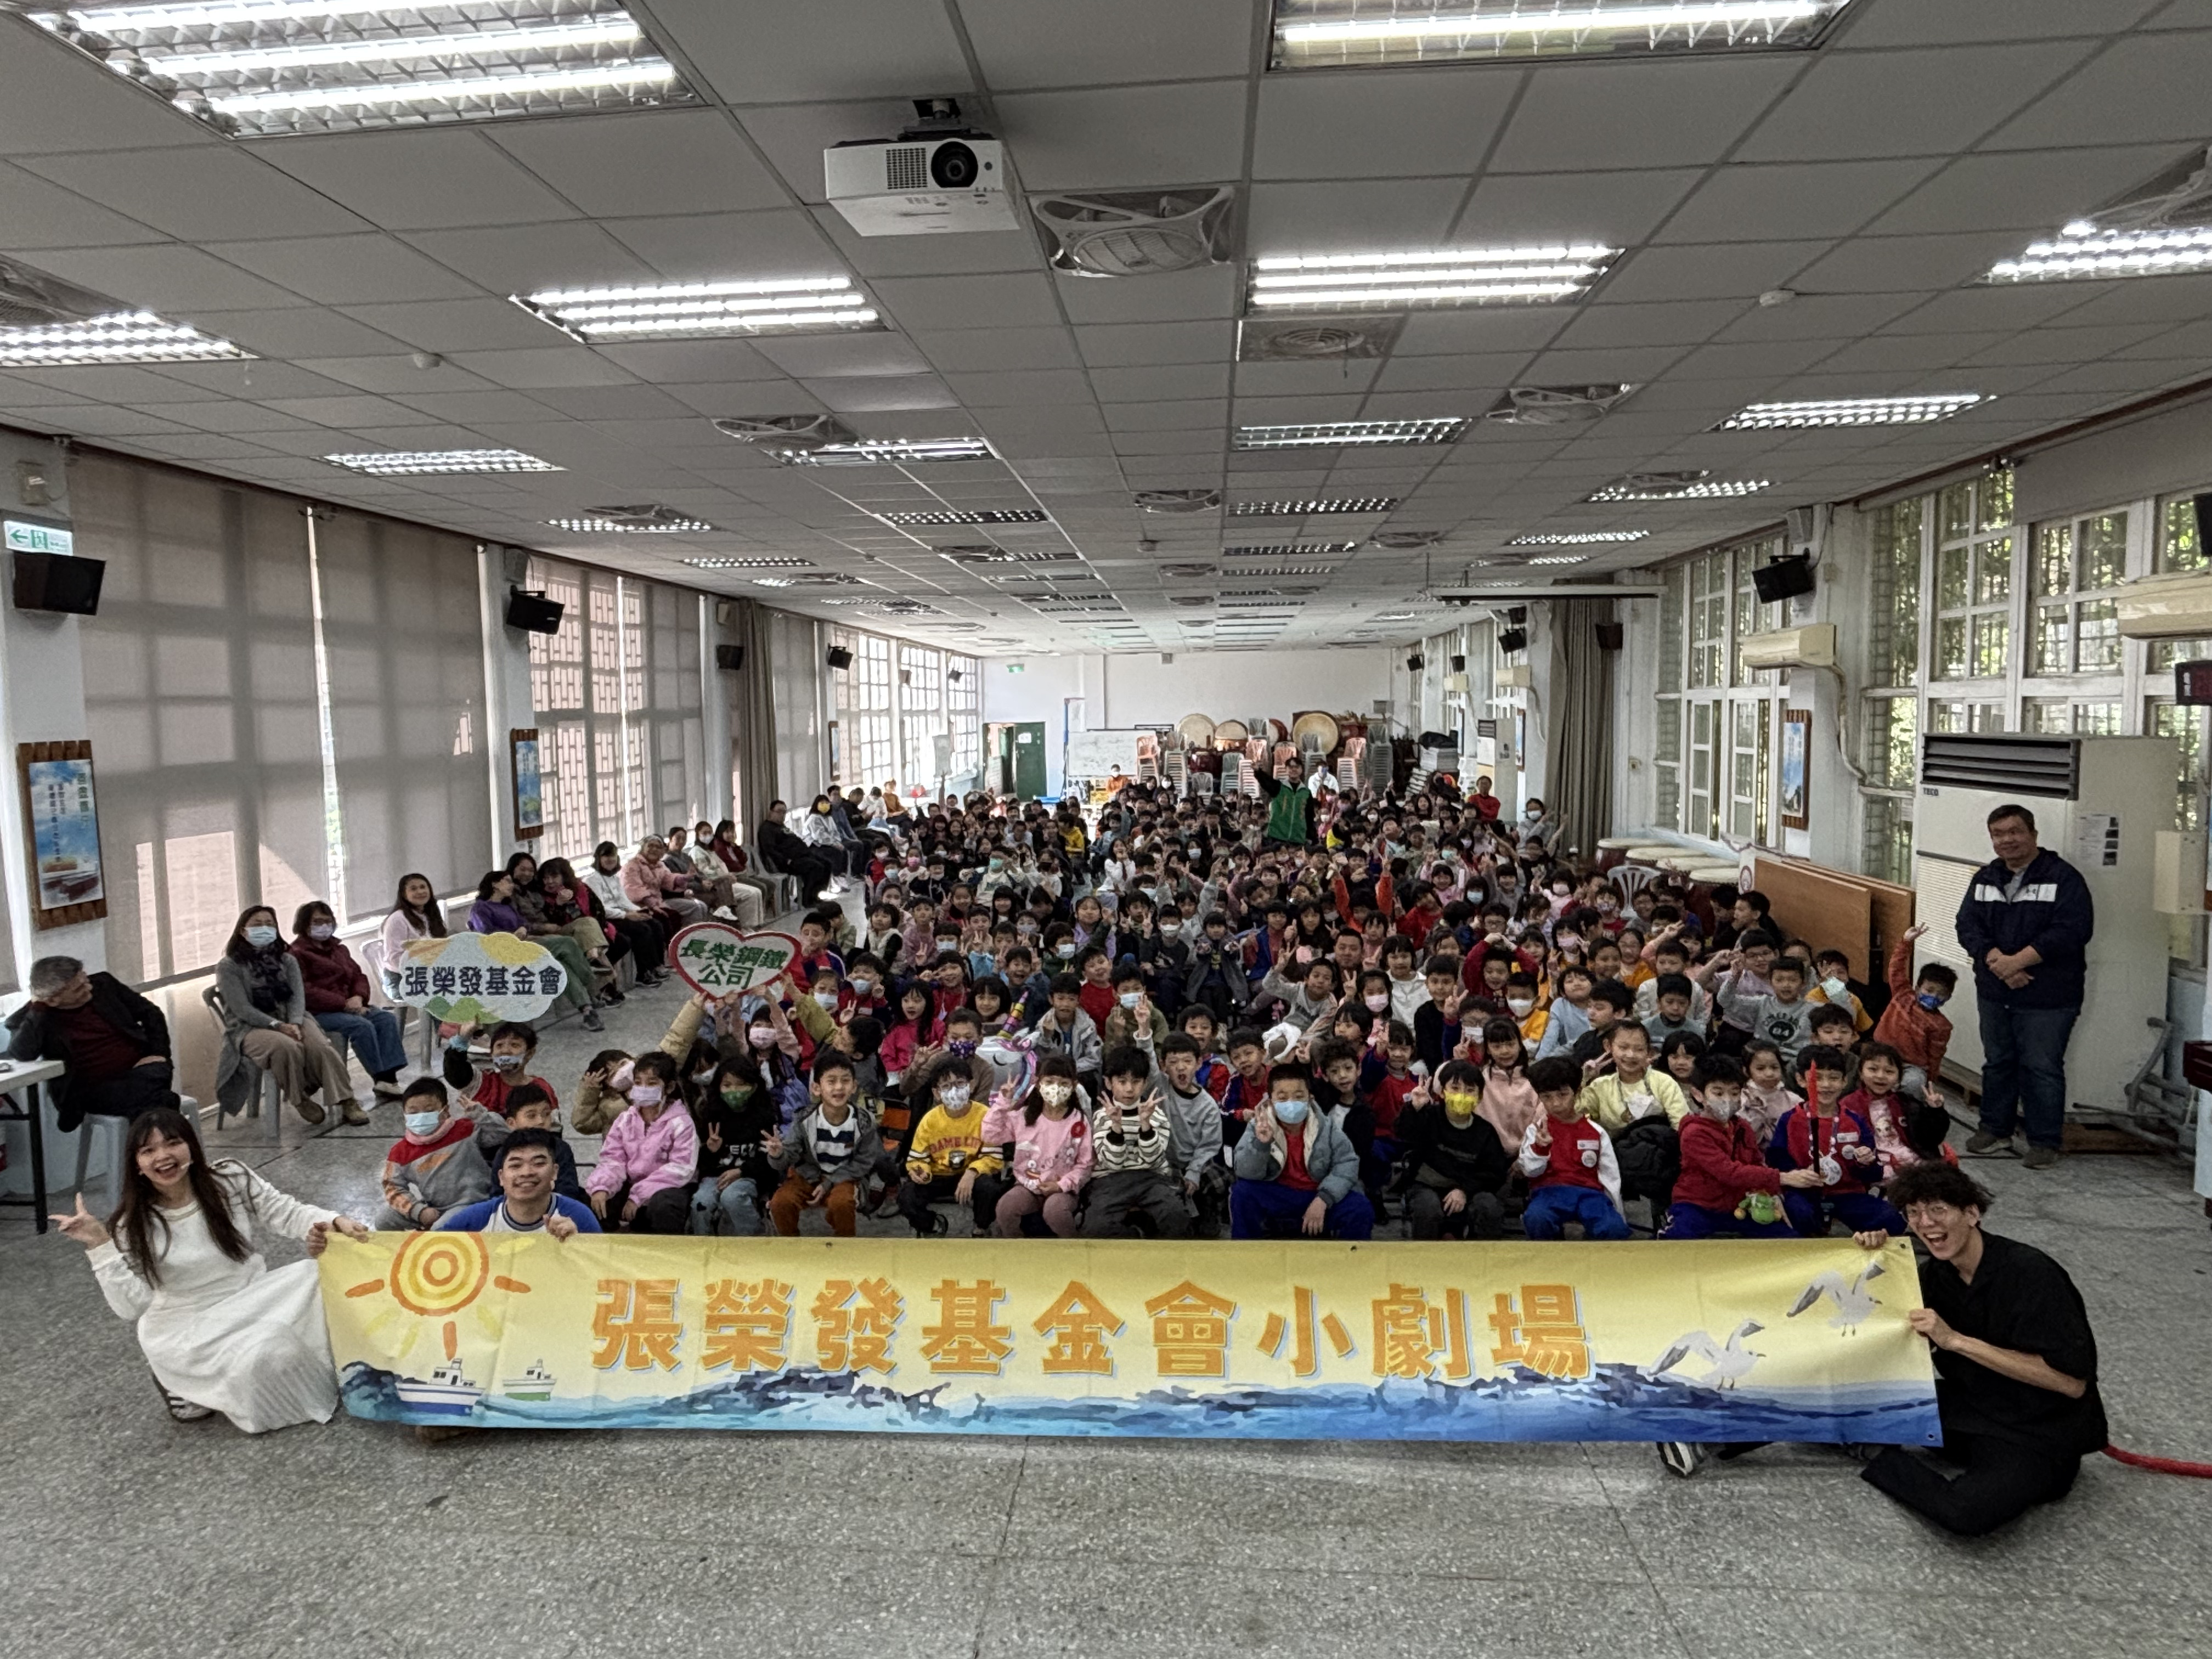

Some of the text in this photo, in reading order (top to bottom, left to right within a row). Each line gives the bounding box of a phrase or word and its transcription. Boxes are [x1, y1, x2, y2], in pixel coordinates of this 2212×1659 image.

[405, 966, 562, 997] 張榮發基金會
[698, 963, 755, 990] 公司
[591, 1278, 1591, 1379] 張榮發基金會小劇場
